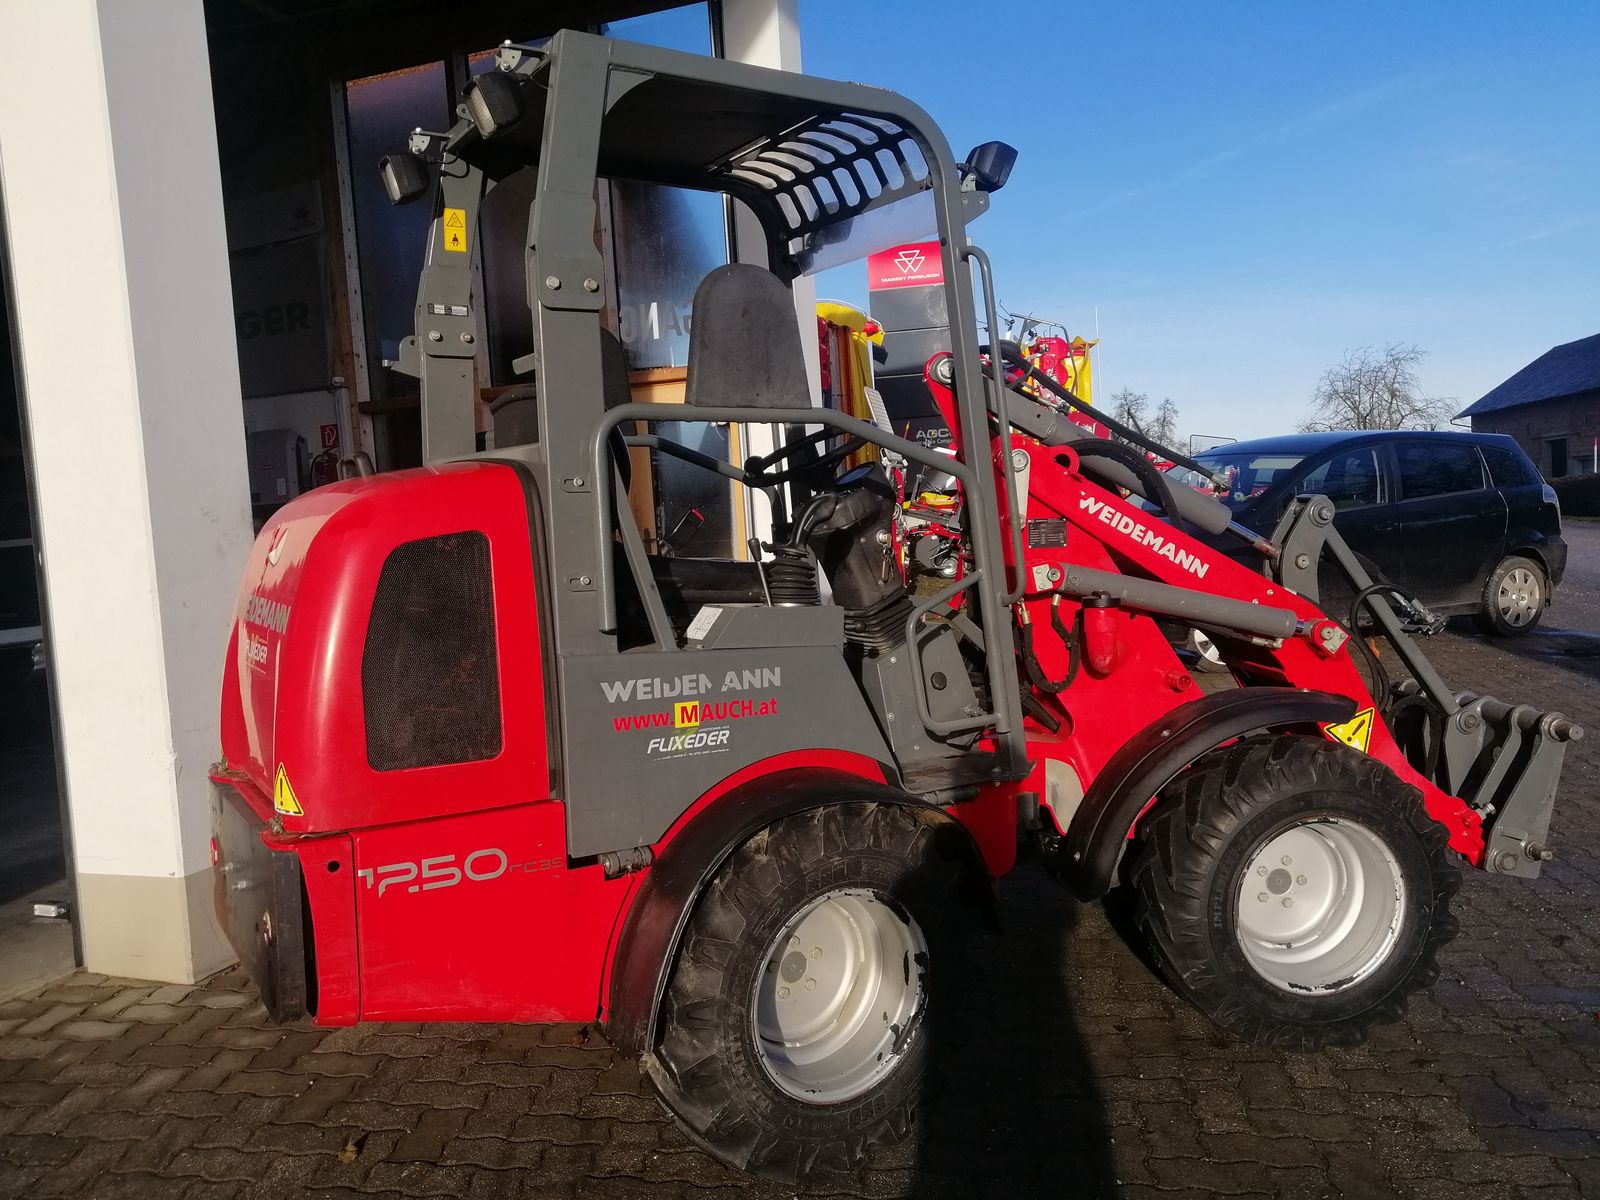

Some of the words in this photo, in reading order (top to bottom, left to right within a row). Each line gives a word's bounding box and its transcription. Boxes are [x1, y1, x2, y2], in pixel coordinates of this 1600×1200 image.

[916, 428, 952, 439] AGC
[1079, 490, 1210, 579] WEIDEMANN
[647, 730, 730, 754] FLIXEDER
